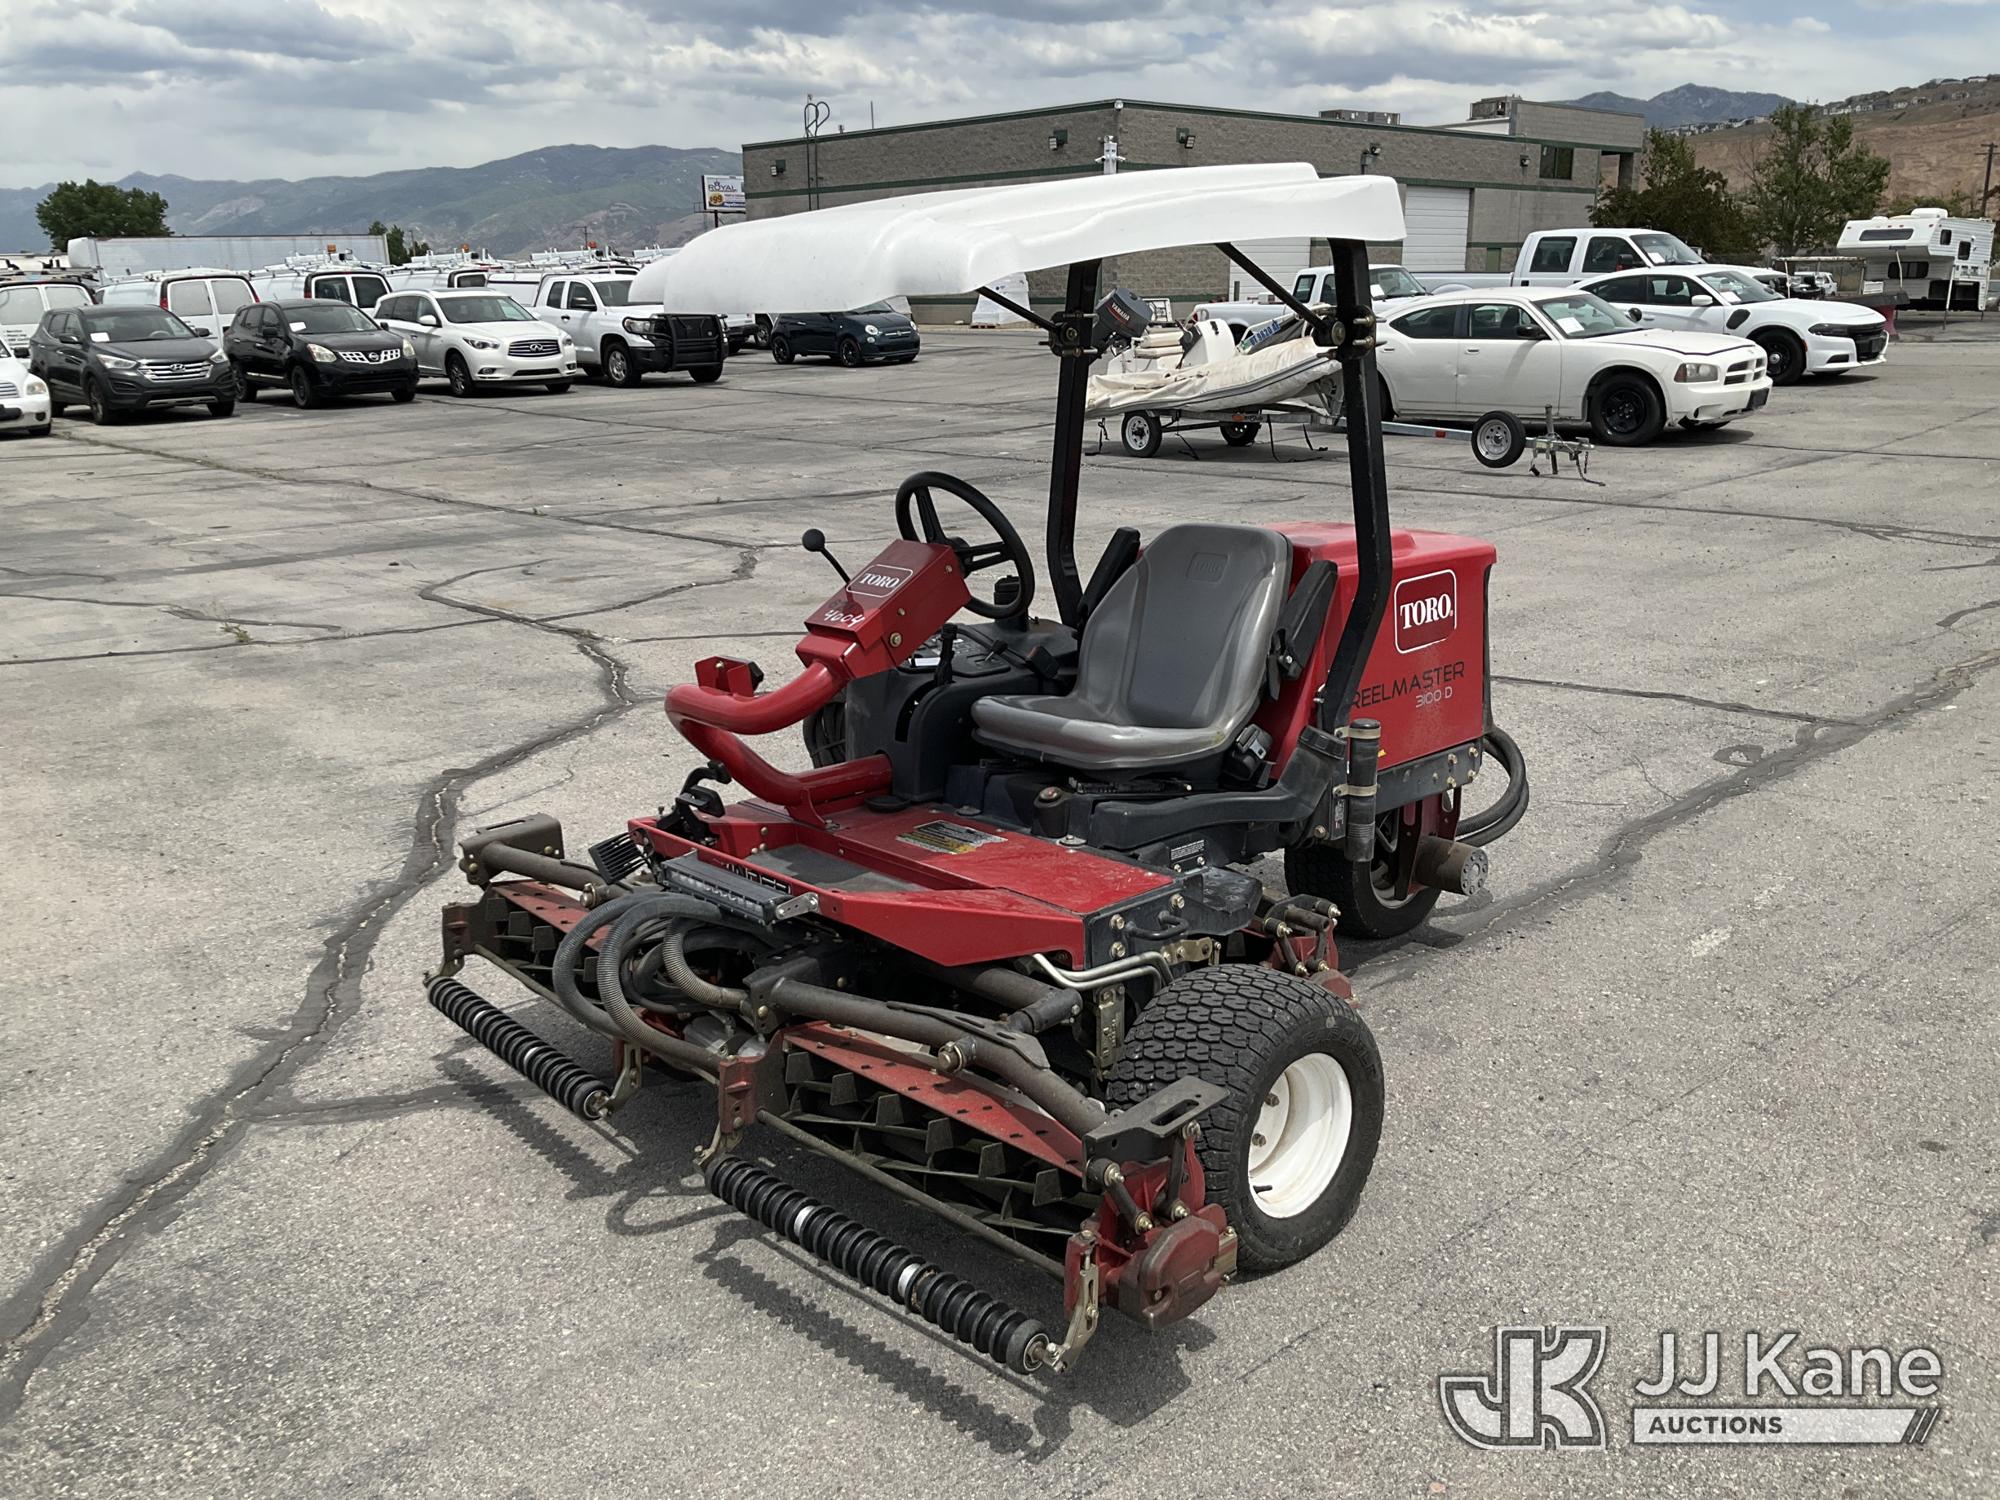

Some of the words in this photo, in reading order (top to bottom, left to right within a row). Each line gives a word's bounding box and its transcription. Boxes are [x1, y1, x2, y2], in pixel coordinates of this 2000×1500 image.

[1111, 302, 1131, 321] YAMAHA
[859, 573, 900, 589] TORO
[1400, 593, 1452, 630] TORO
[1353, 661, 1465, 709] REELMASTER
[1444, 686, 1453, 699] D
